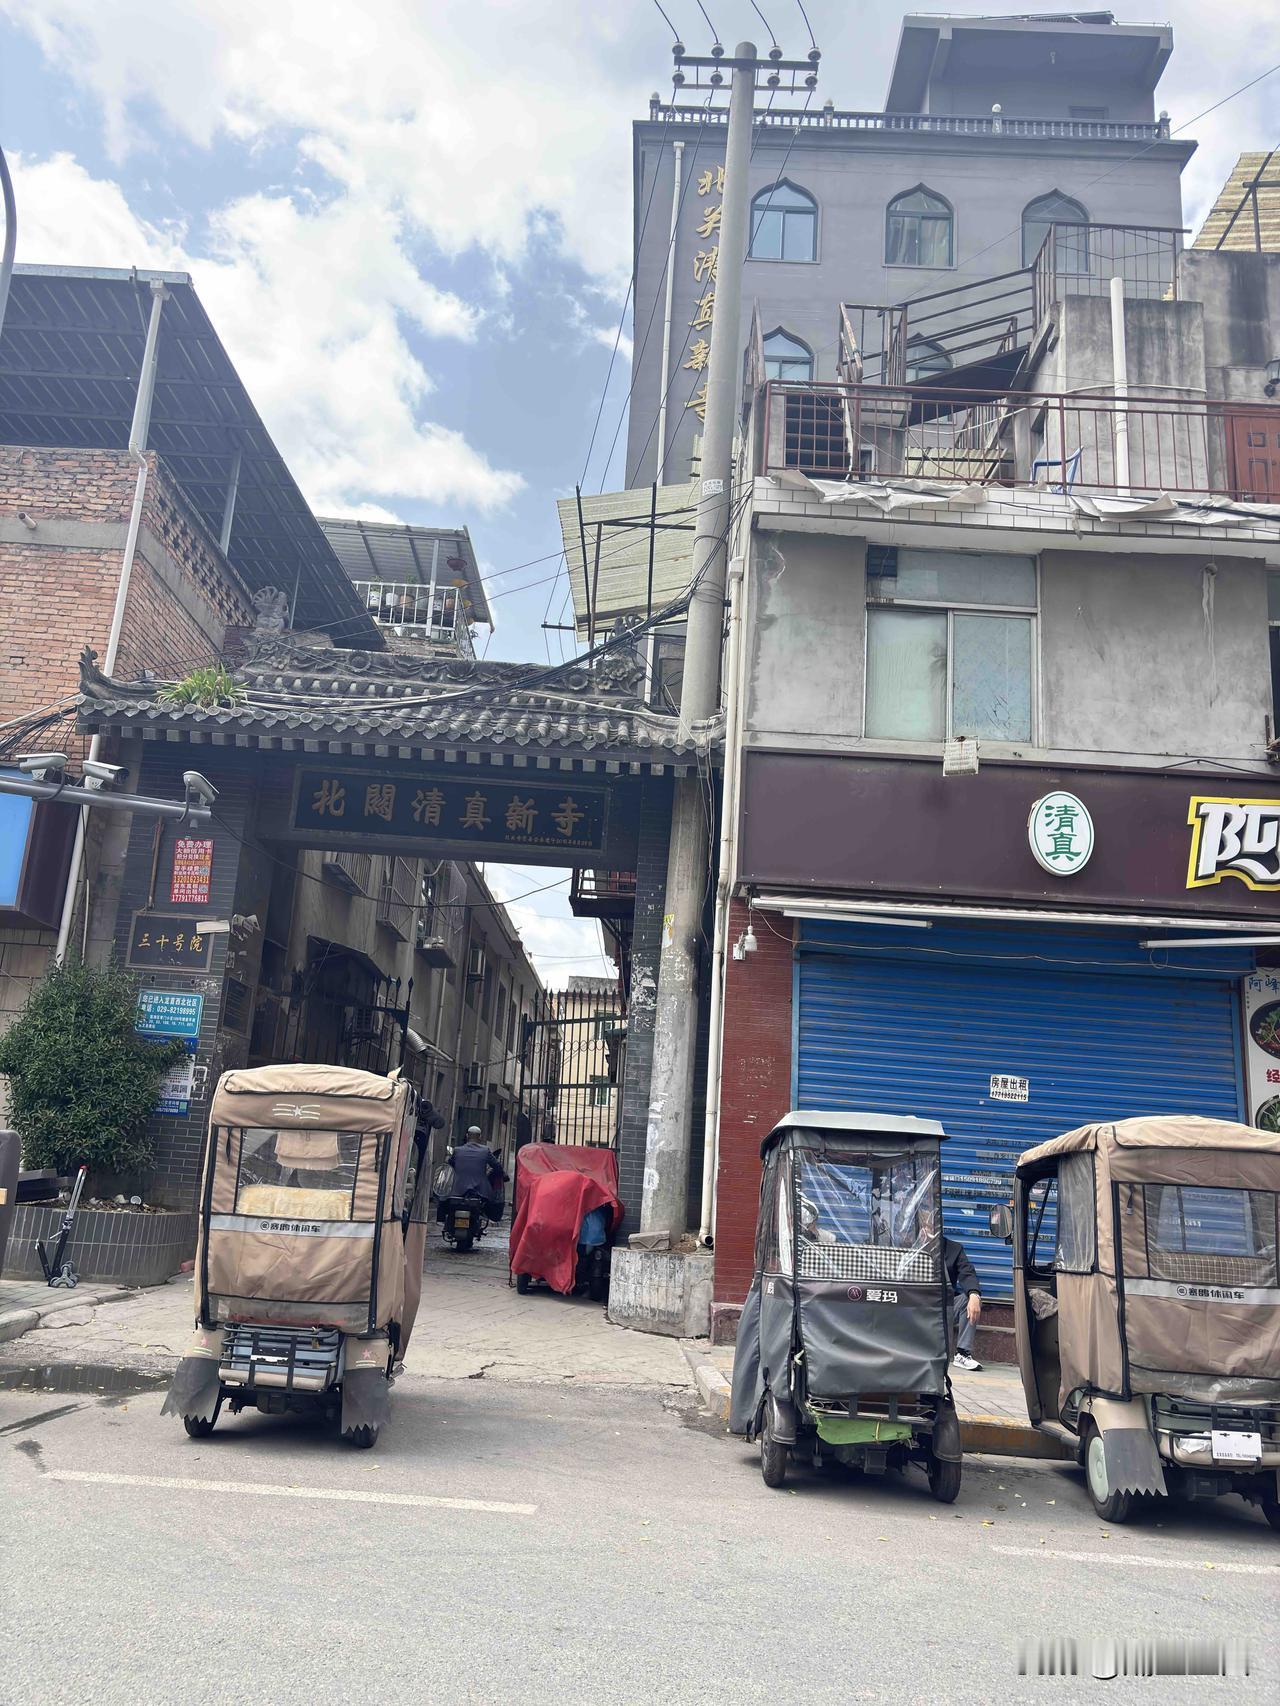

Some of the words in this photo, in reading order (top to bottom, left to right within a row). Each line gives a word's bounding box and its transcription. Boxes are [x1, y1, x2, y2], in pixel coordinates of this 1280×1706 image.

[1044, 804, 1082, 862] 清真
[138, 933, 203, 952] 三十号院
[991, 1077, 1027, 1091] 房屋出租
[866, 1289, 898, 1304] 爱玛
